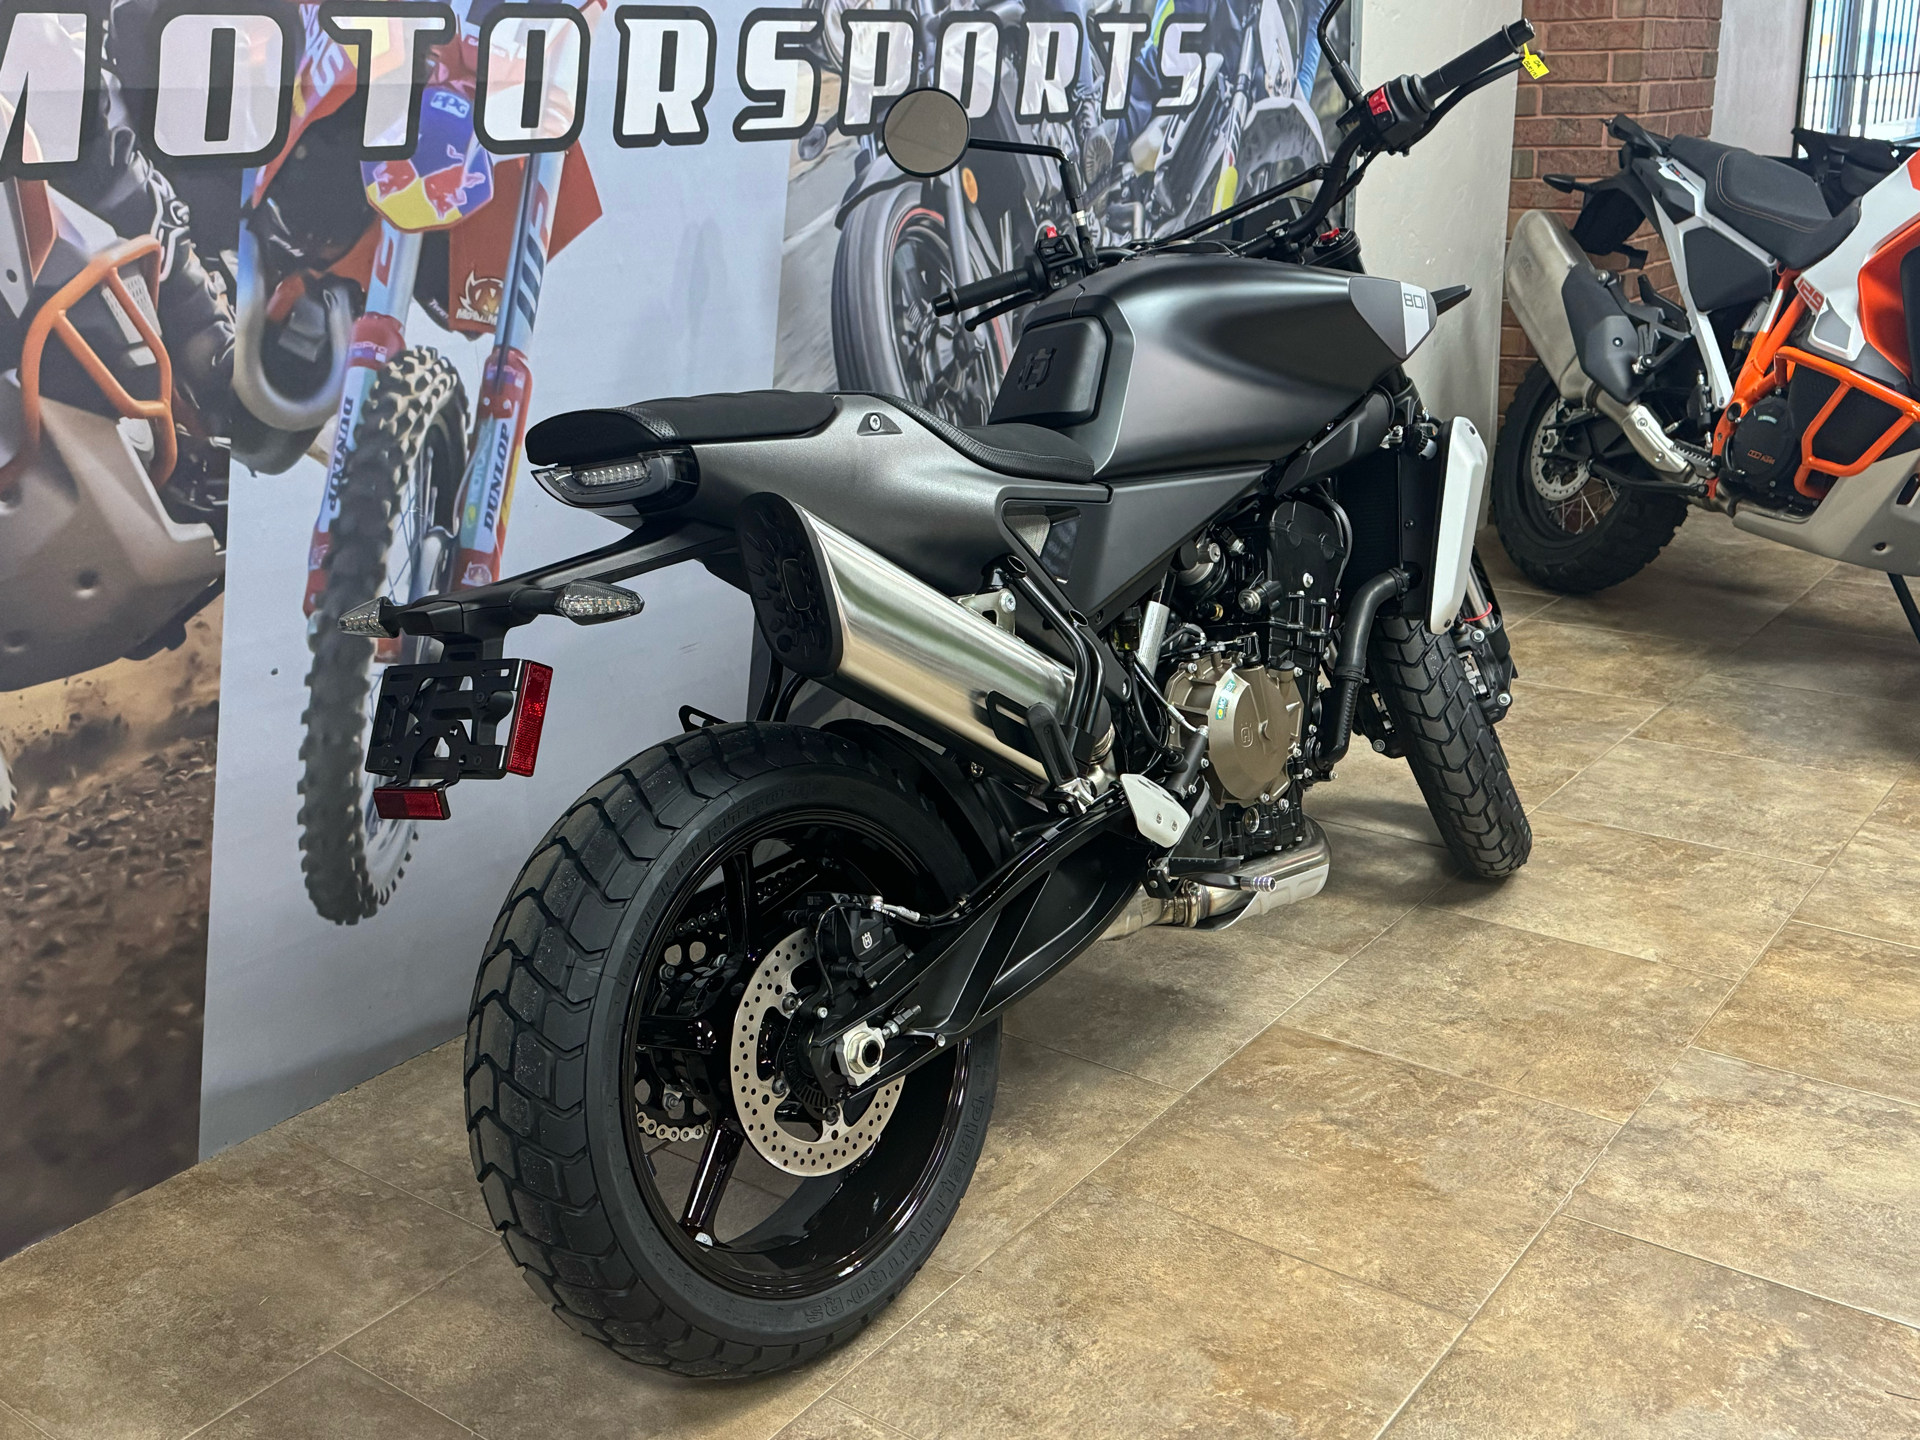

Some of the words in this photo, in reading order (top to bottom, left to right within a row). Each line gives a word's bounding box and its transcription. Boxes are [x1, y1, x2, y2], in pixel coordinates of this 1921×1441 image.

[430, 92, 470, 118] PPG
[1402, 292, 1428, 310] 801
[483, 420, 510, 535] DUNLOP
[919, 1095, 986, 1235] PIRELLI
